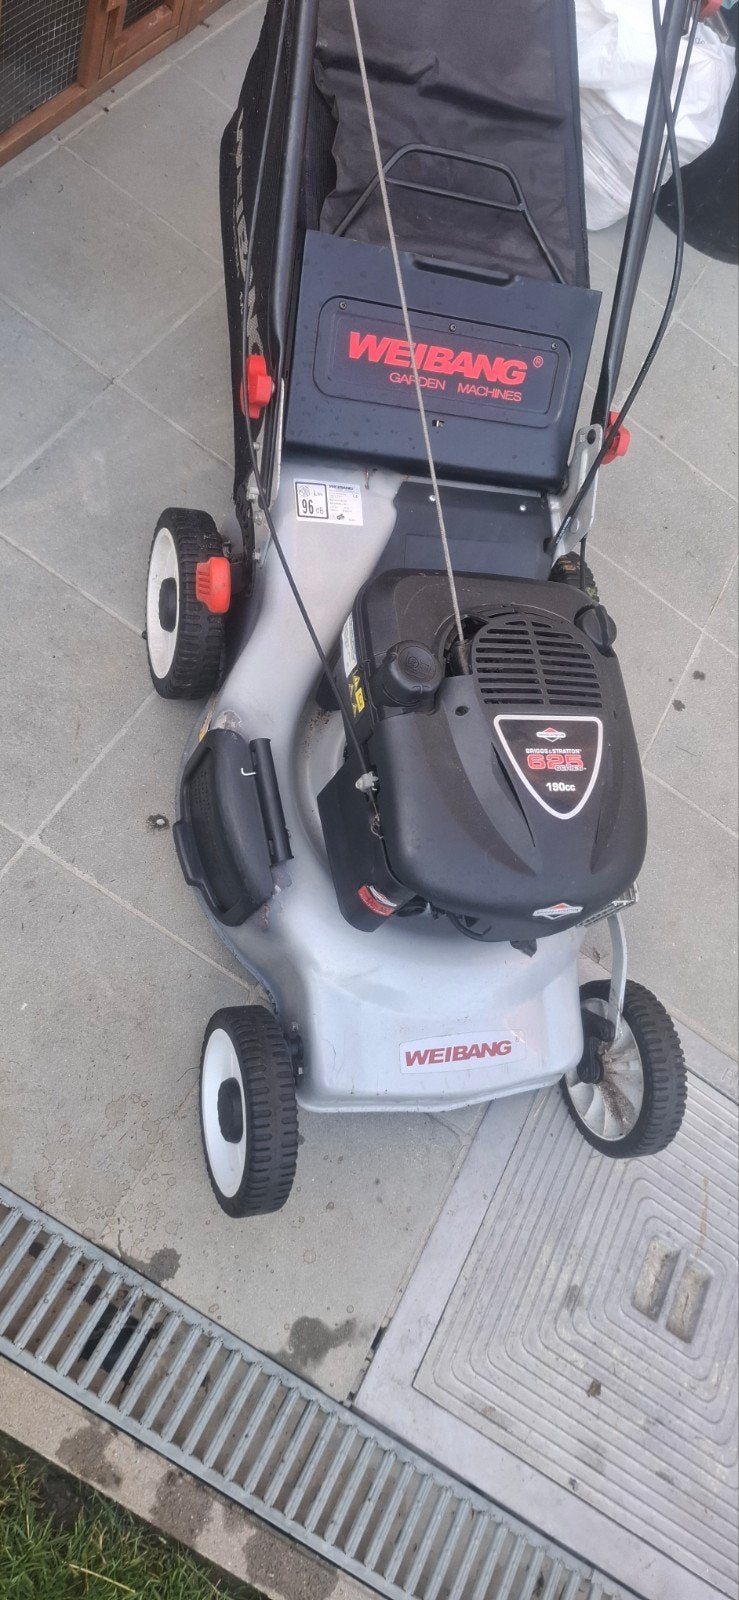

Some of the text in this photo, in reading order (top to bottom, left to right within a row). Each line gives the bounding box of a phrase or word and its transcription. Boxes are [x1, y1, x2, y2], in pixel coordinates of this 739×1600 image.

[348, 331, 528, 385] WEIBANG
[457, 382, 523, 402] MACHINES
[302, 499, 314, 514] 96
[527, 754, 584, 769] 625
[545, 782, 576, 792] 190cc
[405, 1040, 512, 1067] WEIBANG
